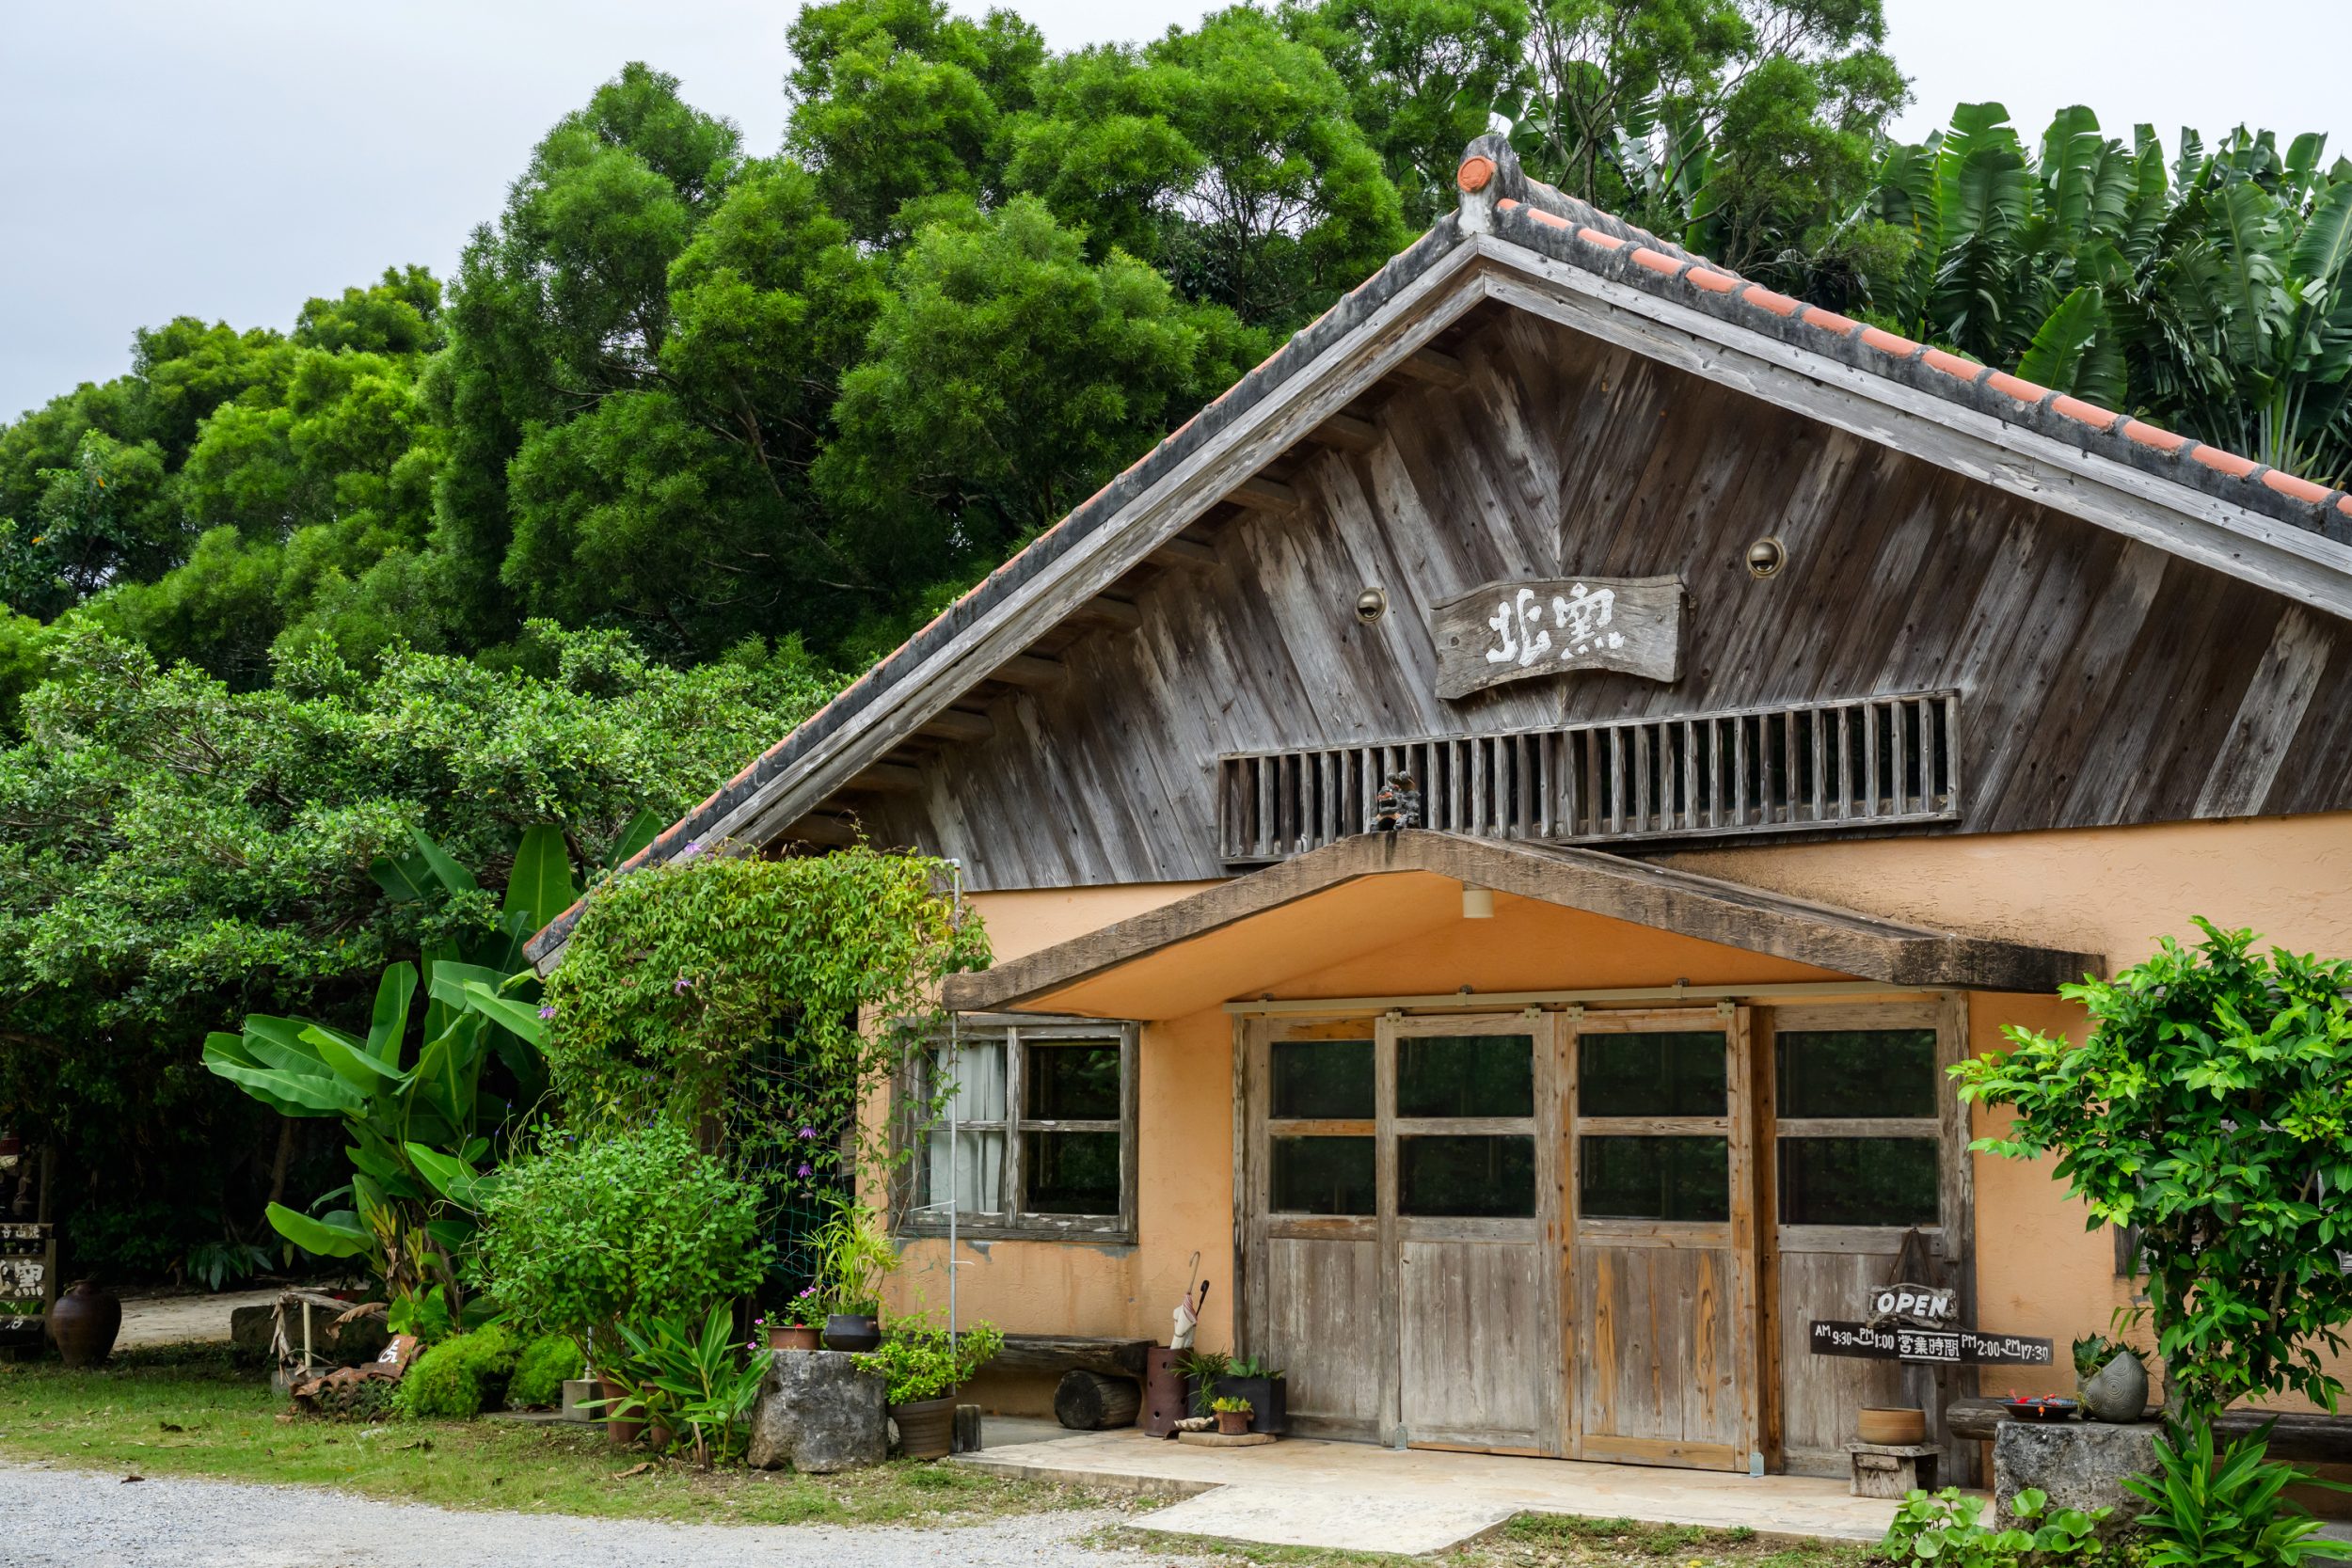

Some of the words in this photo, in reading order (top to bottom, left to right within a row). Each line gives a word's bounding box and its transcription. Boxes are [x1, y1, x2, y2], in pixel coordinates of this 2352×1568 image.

[1878, 1292, 1948, 1317] OPEN
[1815, 1324, 1831, 1337] AM
[1859, 1327, 1874, 1340] PM
[1898, 1335, 1960, 1357] 営業時間
[1962, 1334, 1977, 1349] PM
[2005, 1338, 2021, 1353] PM
[2021, 1344, 2049, 1360] 17:30
